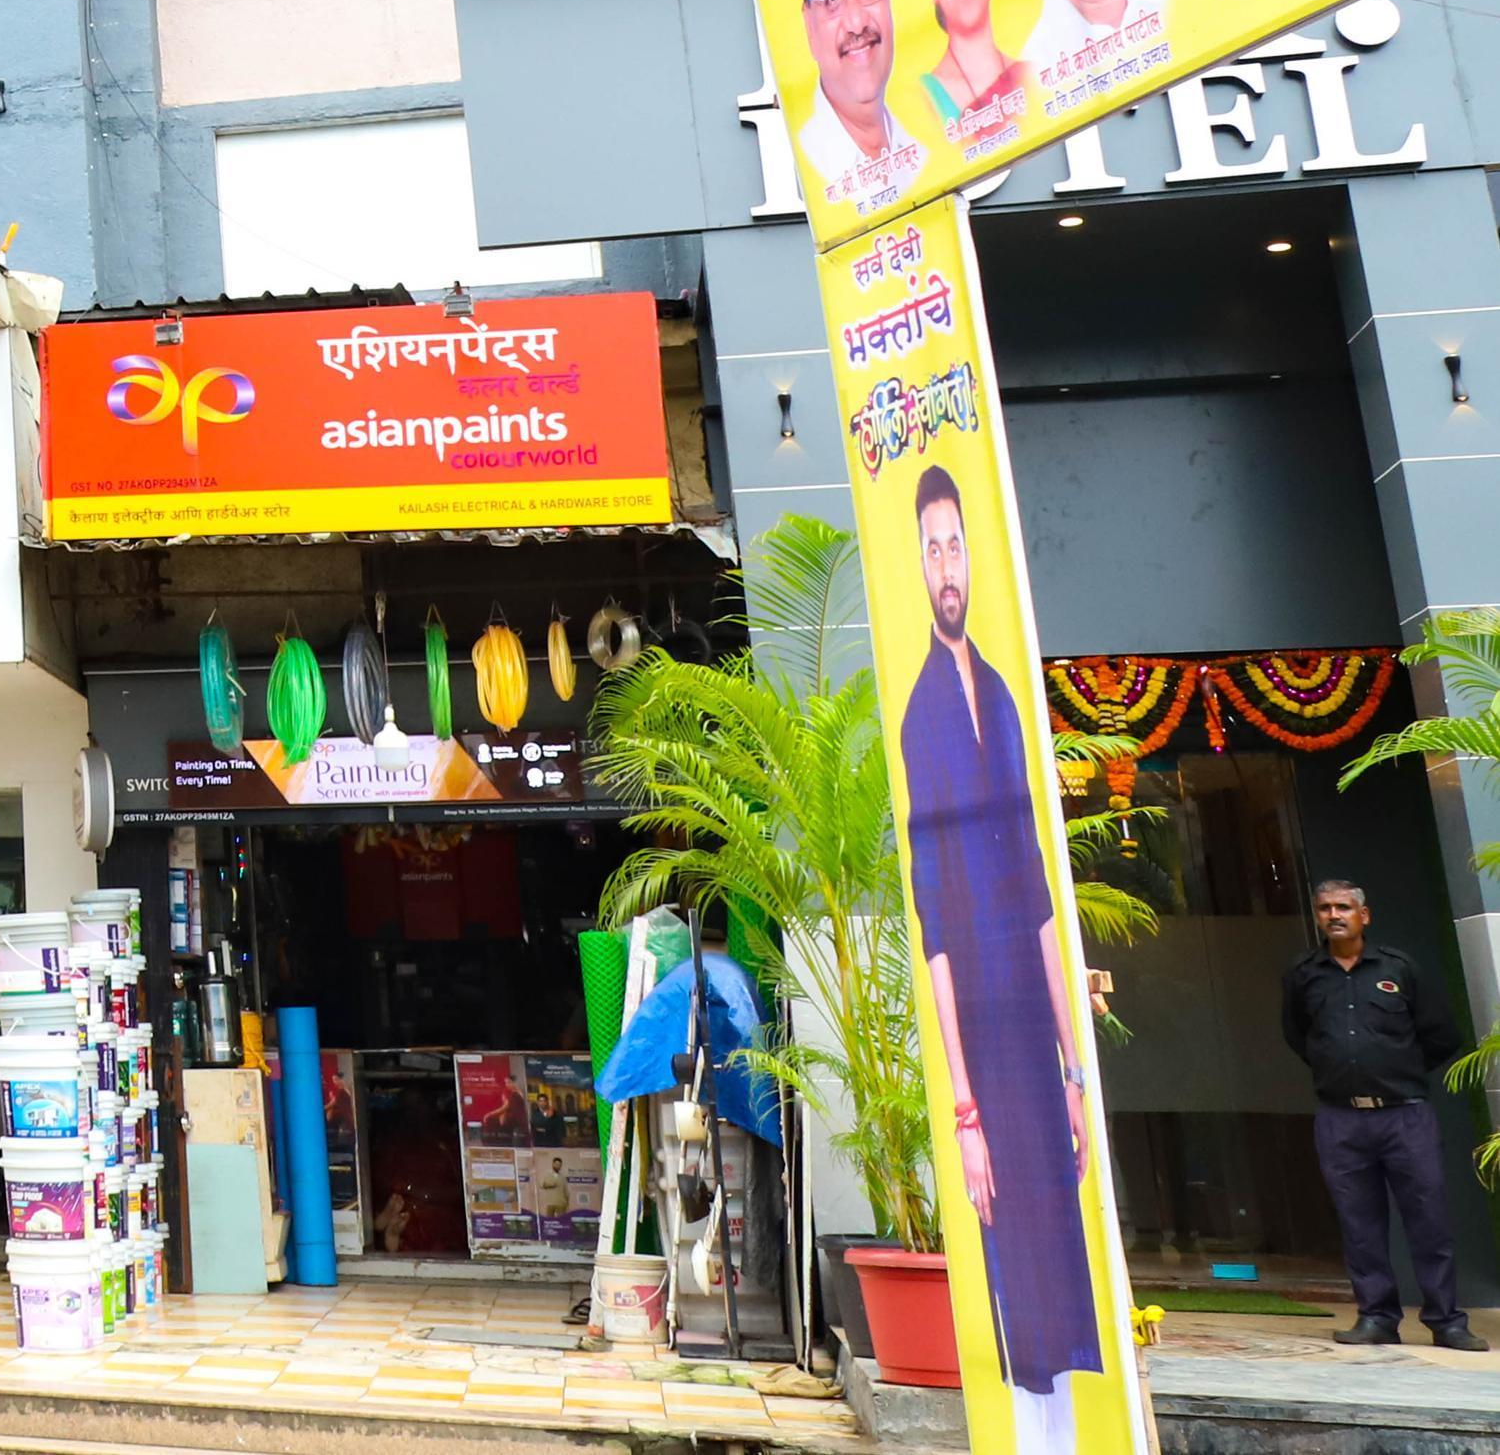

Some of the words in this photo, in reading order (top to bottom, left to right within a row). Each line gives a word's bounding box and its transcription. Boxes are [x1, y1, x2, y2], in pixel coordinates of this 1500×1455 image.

[853, 238, 884, 285] सर्व
[886, 227, 922, 273] देवी
[844, 274, 951, 362] भक्तांचे
[457, 375, 519, 399] कलर
[526, 363, 581, 396] वर्ल्ड
[321, 404, 569, 463] asianpaints
[70, 482, 92, 493] GST
[398, 502, 449, 514] KAILASH
[452, 500, 526, 513] ELECTRICAL
[528, 499, 537, 510] &
[540, 497, 609, 510] HARDWARE
[613, 495, 653, 507] STORE
[175, 760, 214, 772] Painting
[214, 760, 228, 769] On
[175, 776, 203, 788] Every
[204, 775, 232, 785] Time!
[316, 787, 371, 799] Service
[123, 813, 149, 822] GSTIN
